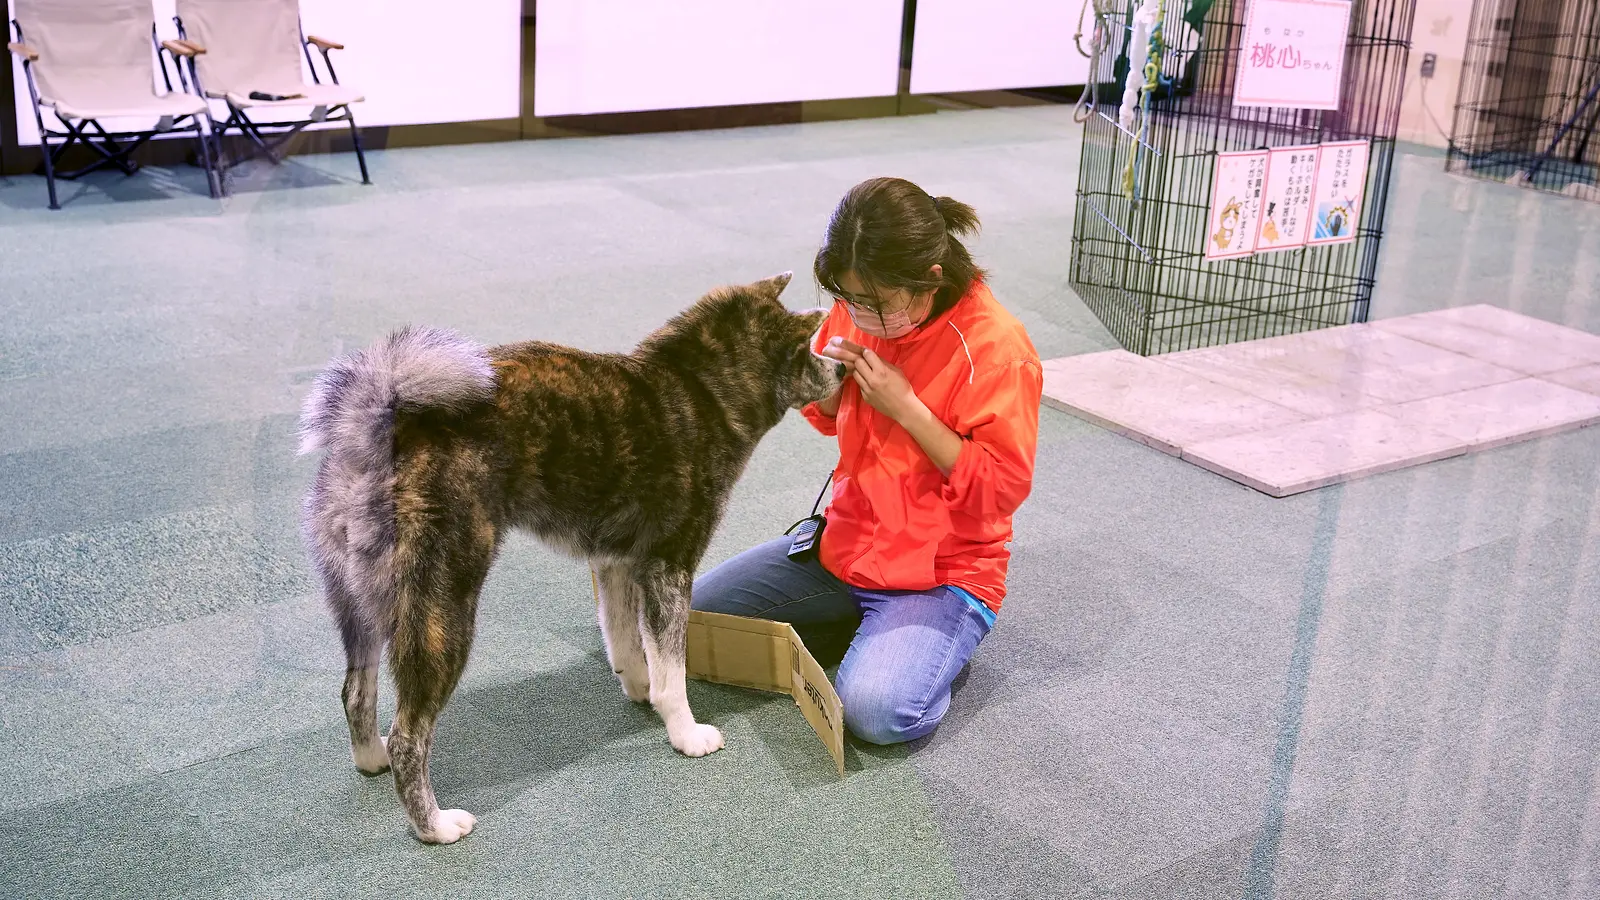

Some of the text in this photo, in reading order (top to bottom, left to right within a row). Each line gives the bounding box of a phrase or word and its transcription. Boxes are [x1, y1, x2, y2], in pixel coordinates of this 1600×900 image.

[1250, 42, 1333, 71] 桃心ちゃん
[1331, 148, 1344, 198] たたかない
[1341, 148, 1352, 188] ガラスを
[1287, 154, 1306, 237] キーホルダーなど
